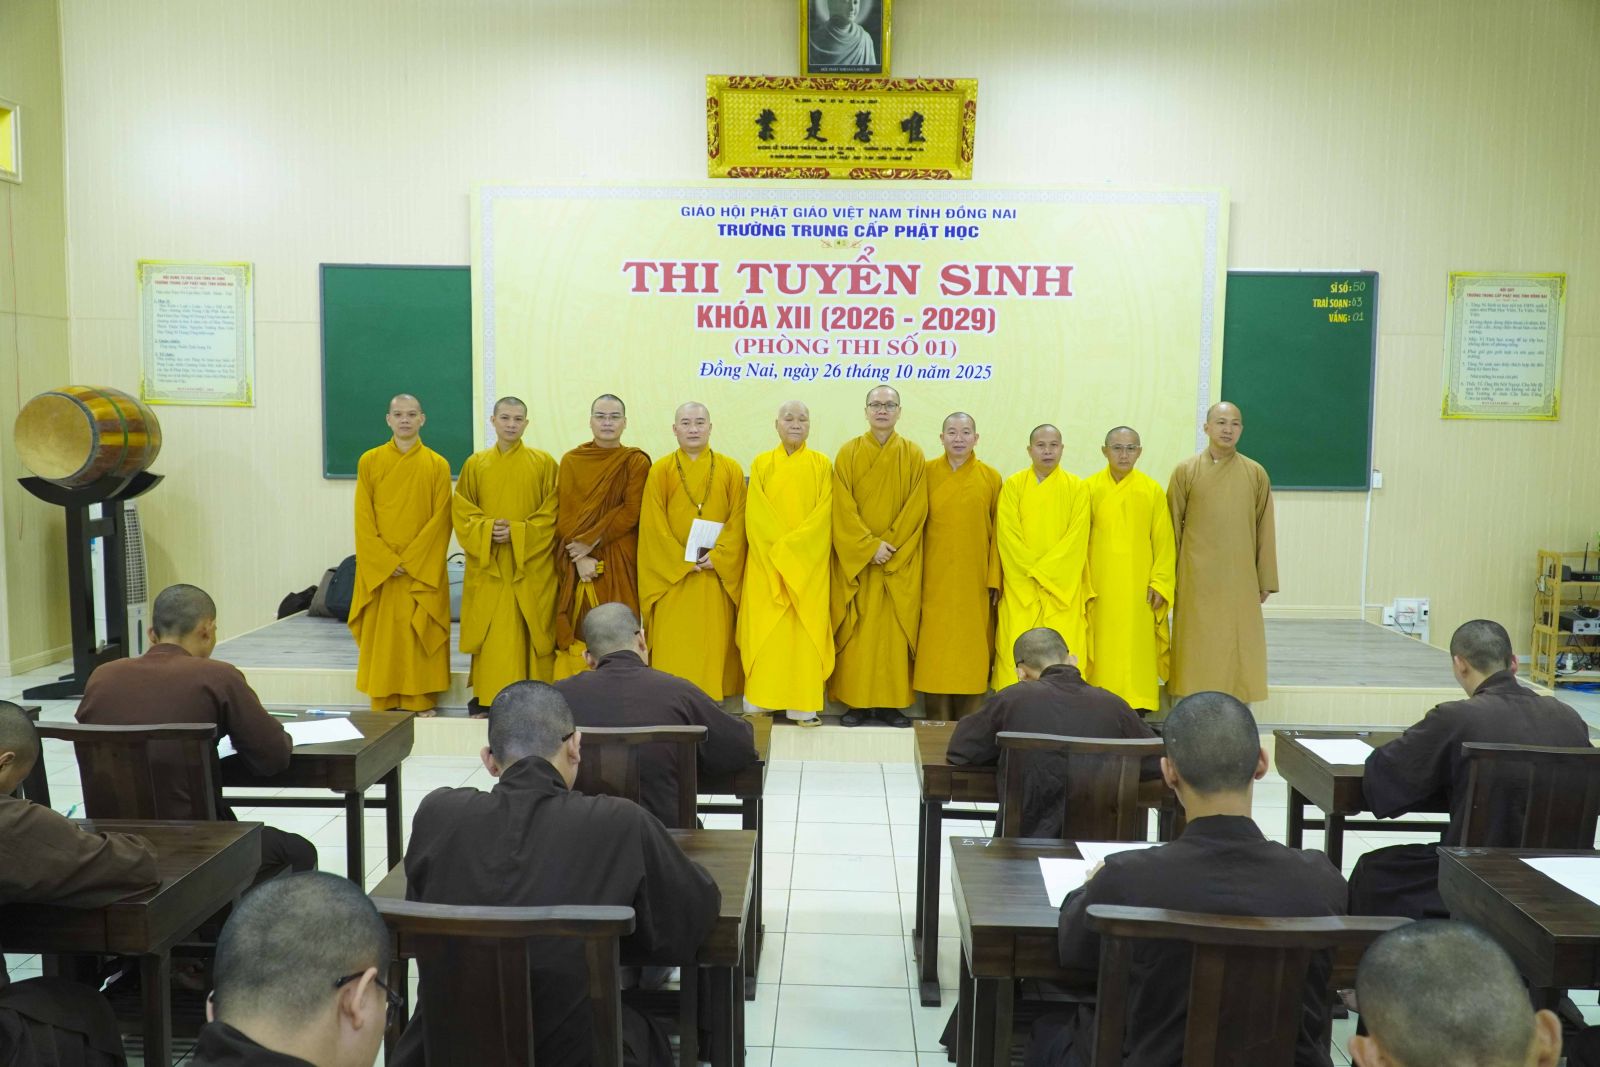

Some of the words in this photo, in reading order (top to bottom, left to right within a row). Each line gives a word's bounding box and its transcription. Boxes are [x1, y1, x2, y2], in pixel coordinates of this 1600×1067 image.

[681, 205, 716, 217] GIÁO
[720, 205, 746, 219] HỘI
[750, 206, 789, 220] PHẬT
[793, 206, 828, 218] GIÁO
[833, 206, 864, 220] VIỆT
[868, 208, 901, 219] NAM
[907, 205, 941, 219] TỈNH
[945, 205, 988, 219] ĐỒNG
[992, 208, 1017, 219] NAI
[717, 221, 786, 237] TRƯỜNG
[791, 224, 848, 237] TRUNG
[854, 220, 889, 238] CẤP
[894, 223, 939, 241] PHẬT
[944, 225, 979, 241] HỌC
[623, 261, 719, 294] THI
[737, 246, 921, 295] TUYỂN
[940, 264, 1074, 297] SINH
[1353, 281, 1366, 292] 50
[696, 301, 768, 330] KHÓA
[776, 305, 811, 330] XII
[821, 306, 895, 332] (2026
[922, 307, 996, 333] 2029)
[1352, 311, 1364, 322] 01
[734, 334, 829, 356] (PHÒNG
[838, 339, 880, 355] THI
[887, 332, 919, 356] SỐ
[926, 340, 957, 358] 01)
[700, 360, 742, 381] Đồng
[746, 363, 778, 380] Nai,
[783, 363, 819, 382] ngày
[824, 363, 842, 378] 26
[846, 363, 891, 382] tháng
[896, 364, 912, 378] 10
[917, 364, 951, 379] năm
[955, 364, 992, 380] 2025
